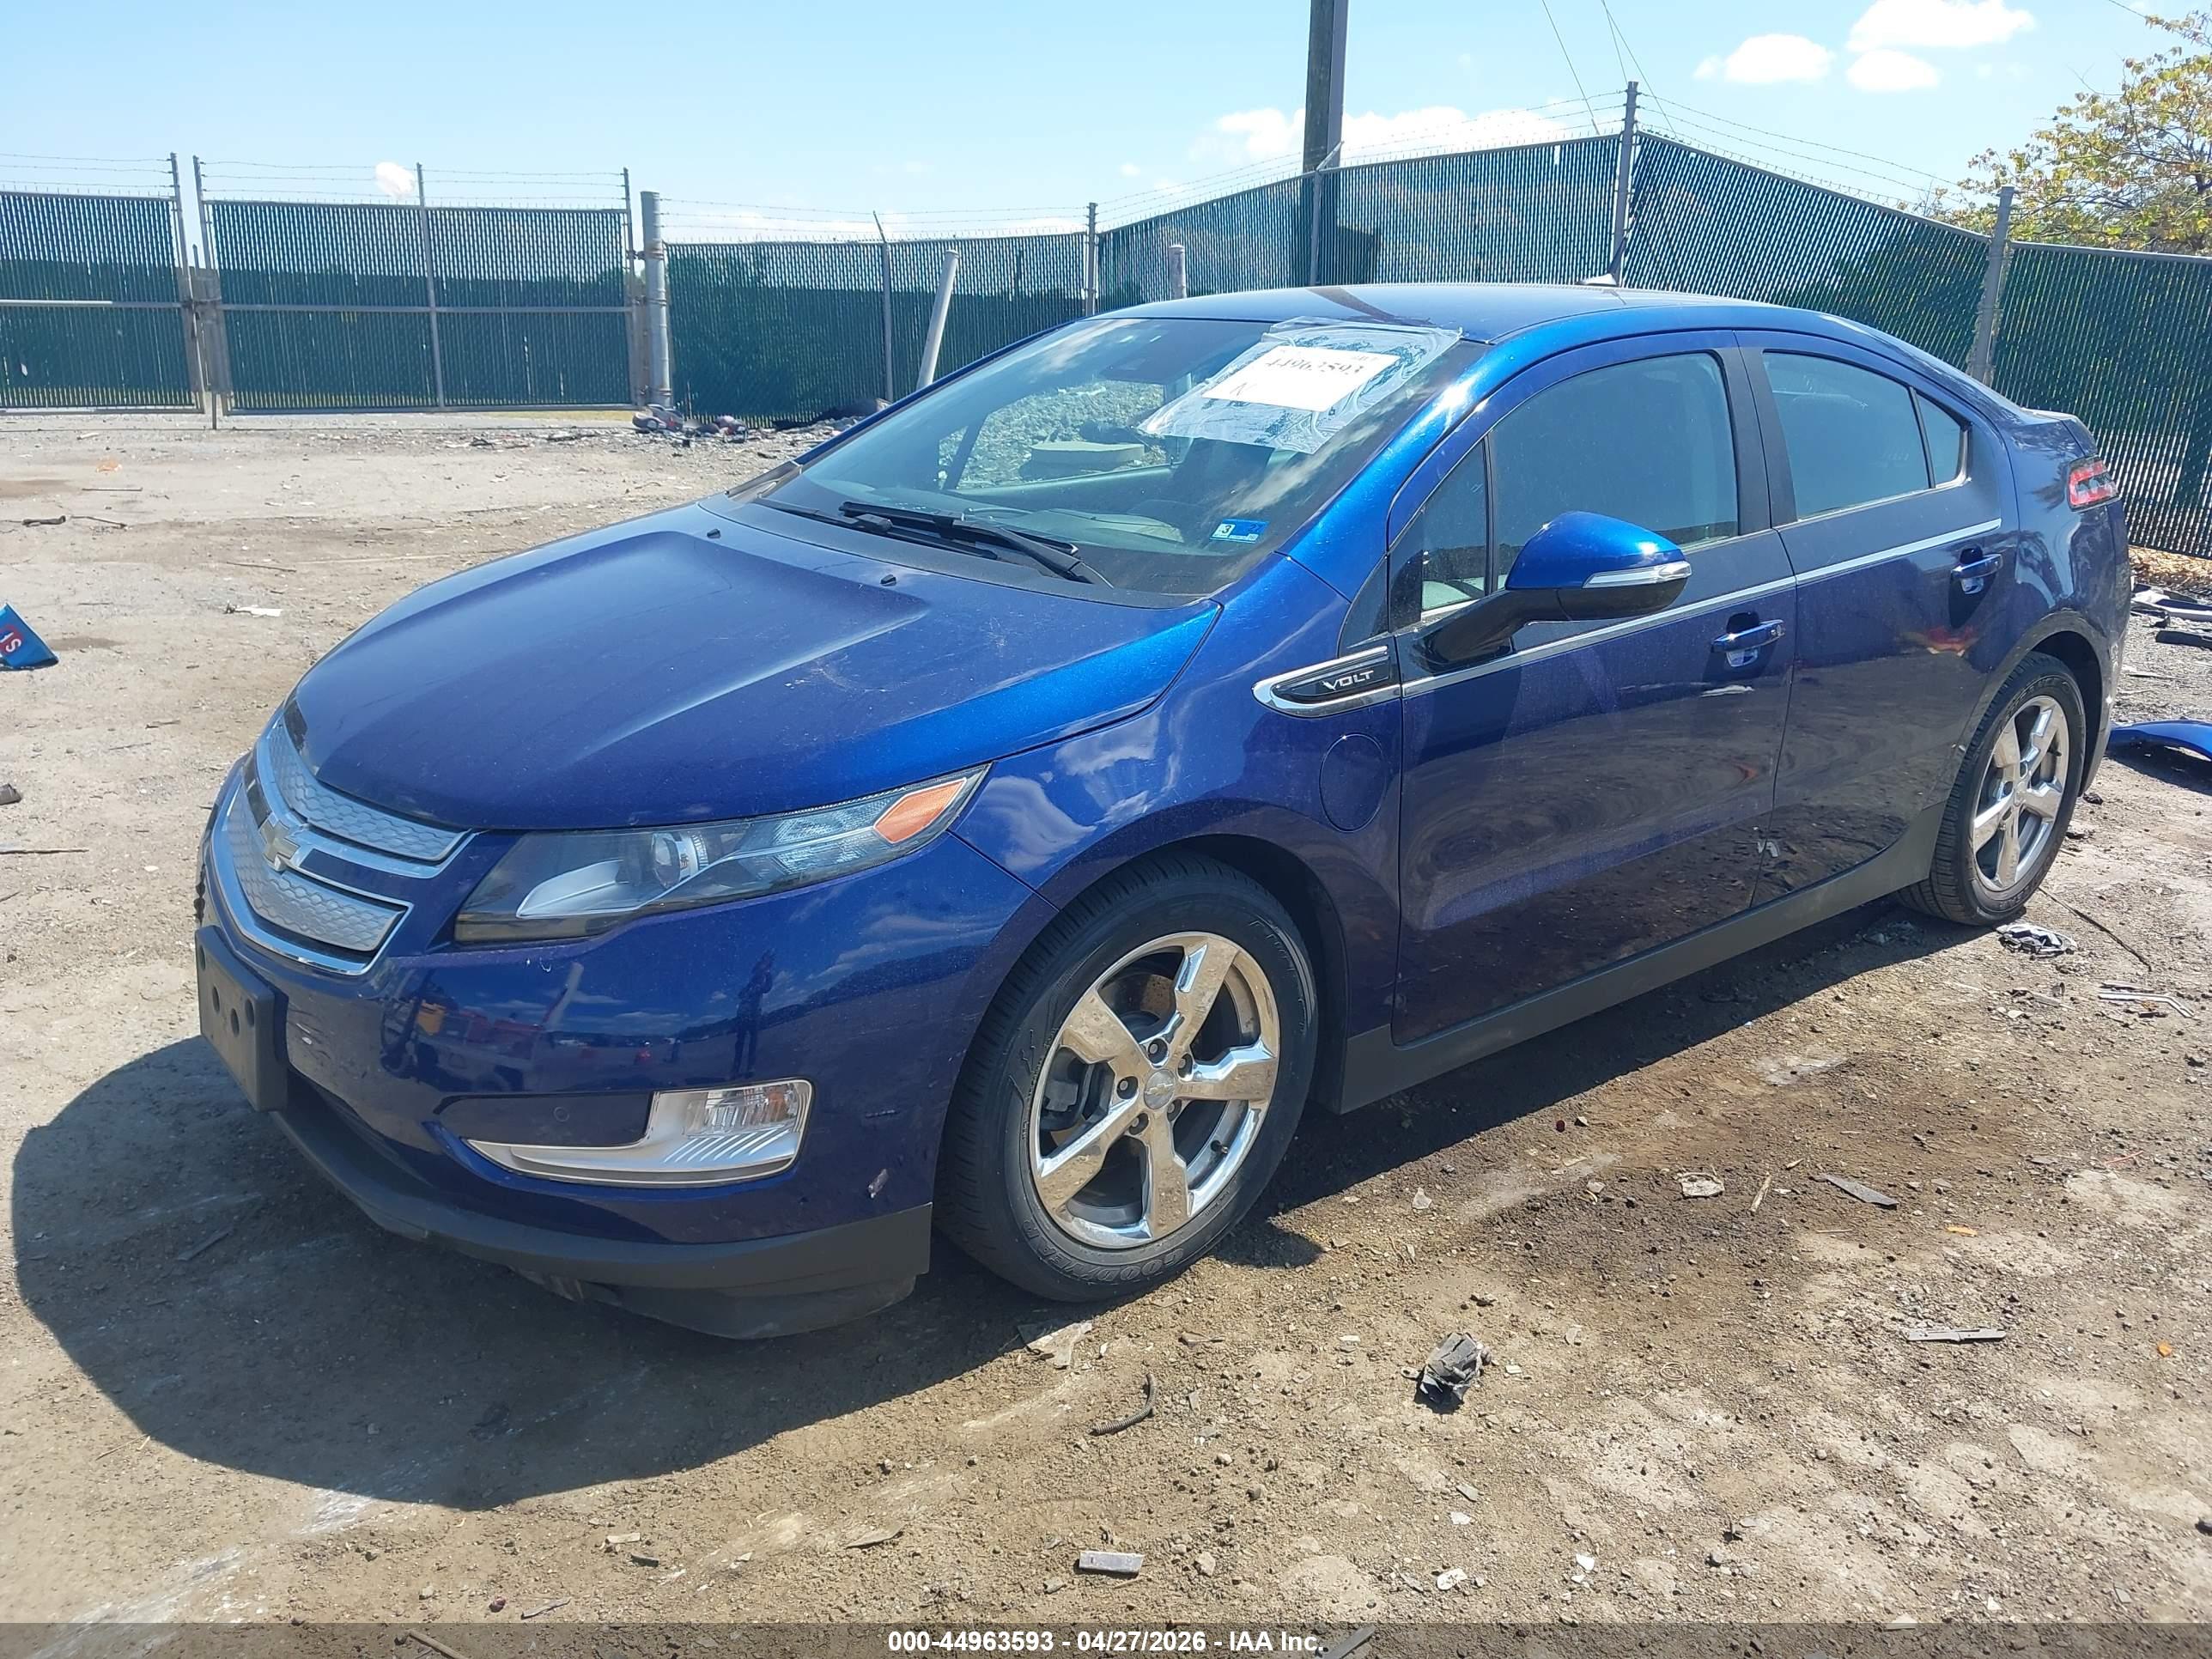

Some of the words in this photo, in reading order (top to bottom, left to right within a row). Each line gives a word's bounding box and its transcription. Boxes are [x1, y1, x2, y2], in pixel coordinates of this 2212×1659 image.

[1221, 525, 1231, 534] 3
[1322, 670, 1374, 691] VOLT
[1023, 1218, 1184, 1282] GOODYEAR
